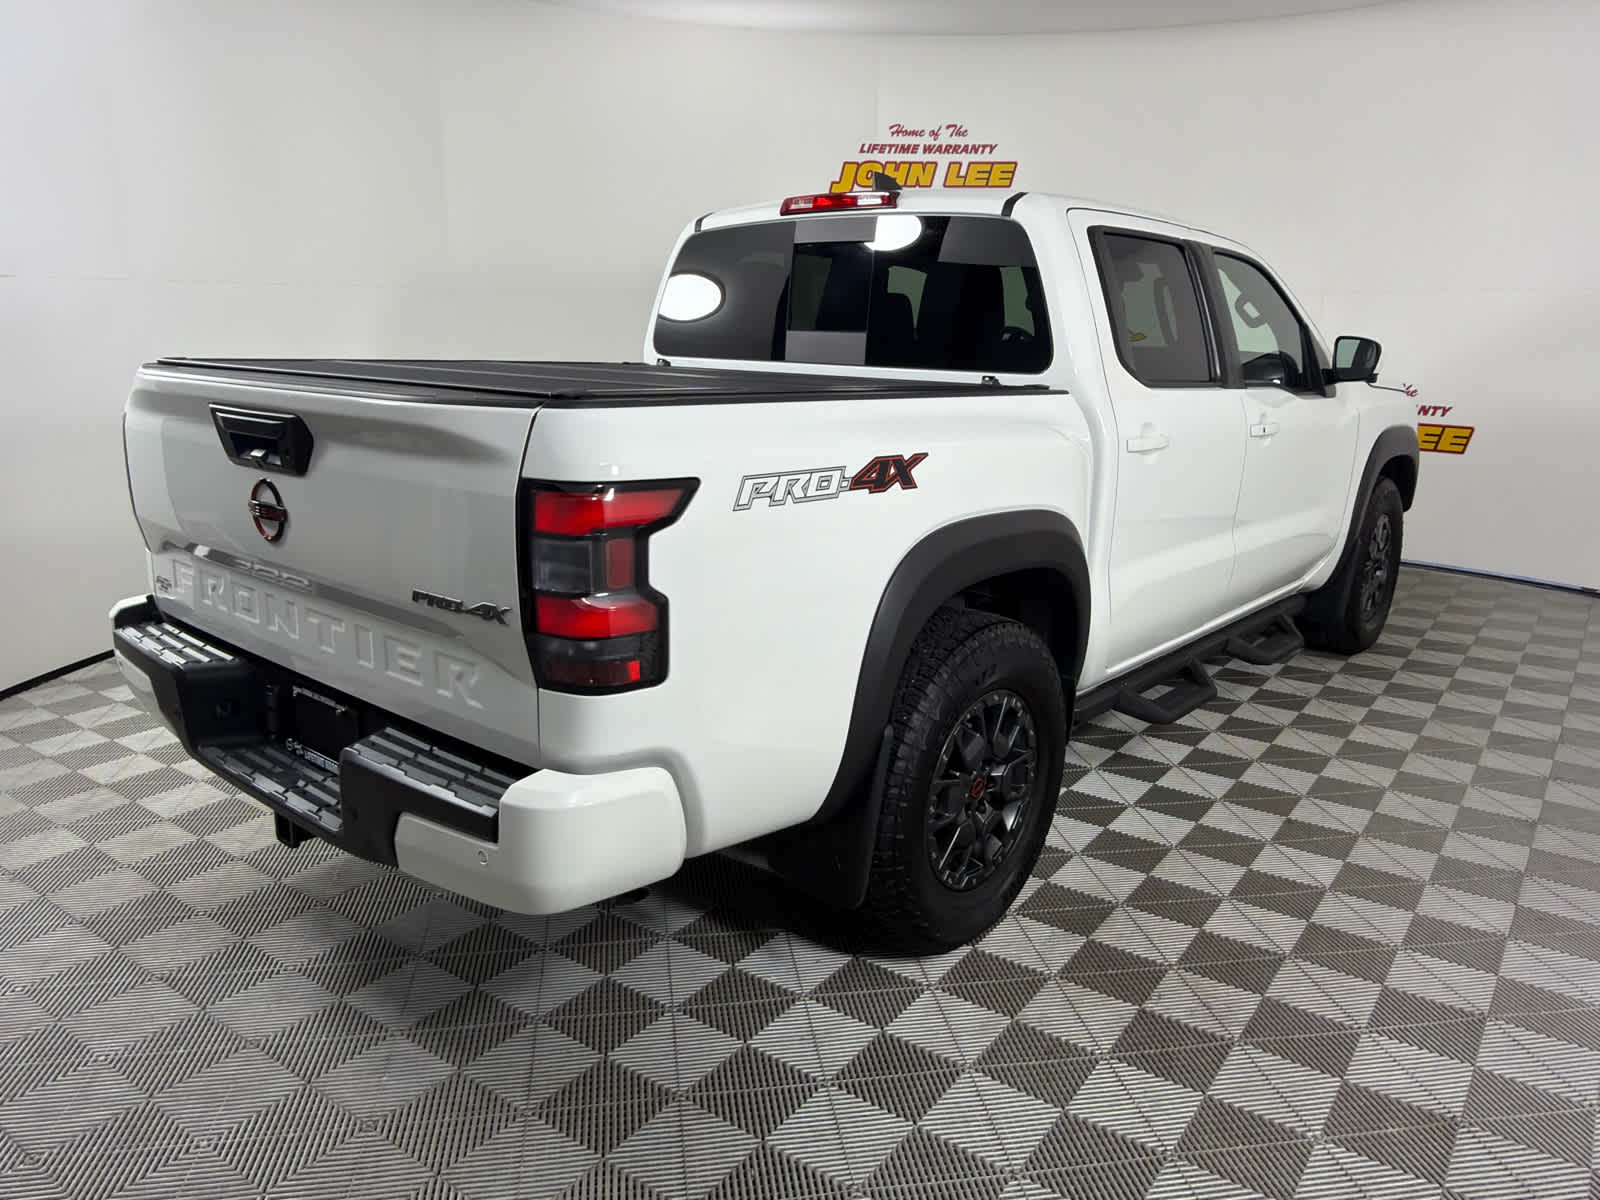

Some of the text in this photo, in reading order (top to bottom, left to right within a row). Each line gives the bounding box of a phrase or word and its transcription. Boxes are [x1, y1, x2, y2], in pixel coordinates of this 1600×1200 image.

[858, 143, 998, 155] LIFETIME WARRANTY
[889, 124, 969, 141] Home of The
[829, 160, 1018, 194] JOHN LEE
[1417, 422, 1475, 455] EE
[171, 558, 484, 710] FRONTIER
